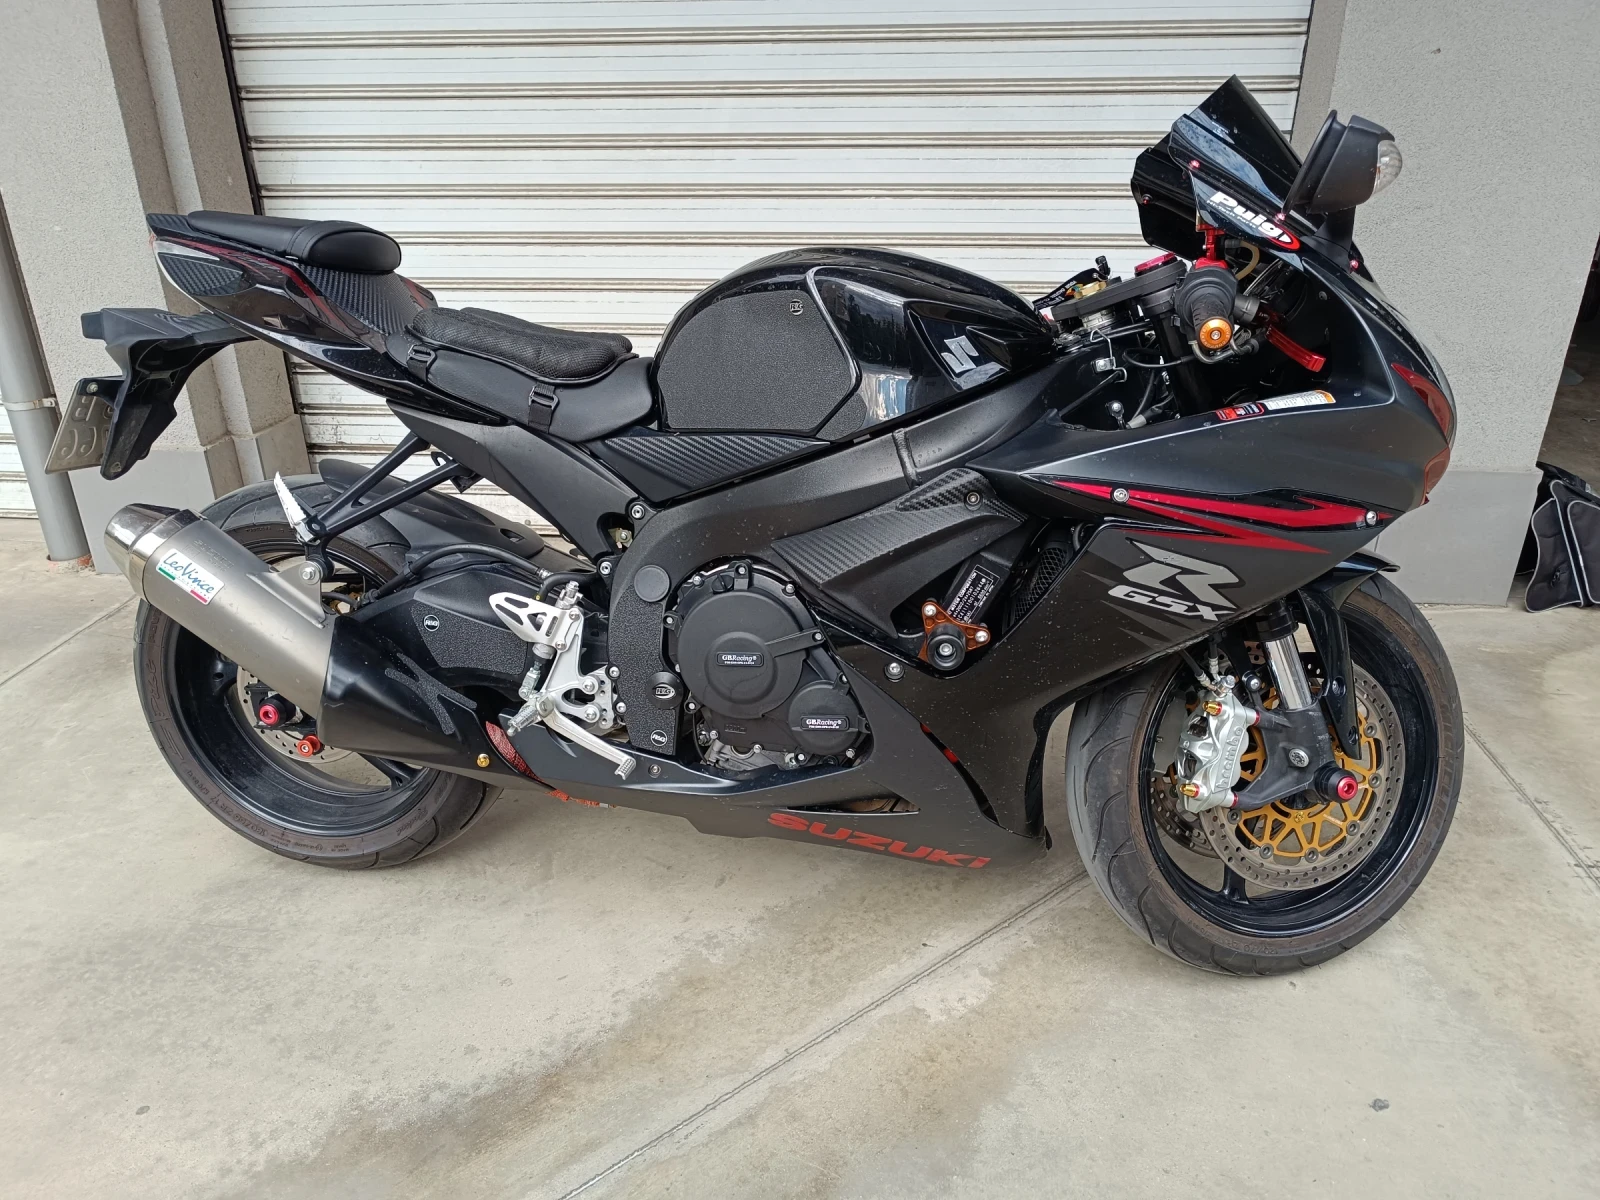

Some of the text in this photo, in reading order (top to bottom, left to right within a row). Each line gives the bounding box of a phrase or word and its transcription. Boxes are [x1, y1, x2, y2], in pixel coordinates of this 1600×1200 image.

[1209, 191, 1283, 238] Puig
[162, 552, 215, 595] LeoVince
[1108, 585, 1235, 621] GSX
[1216, 725, 1244, 788] brembo
[767, 812, 991, 869] SUZUKI
